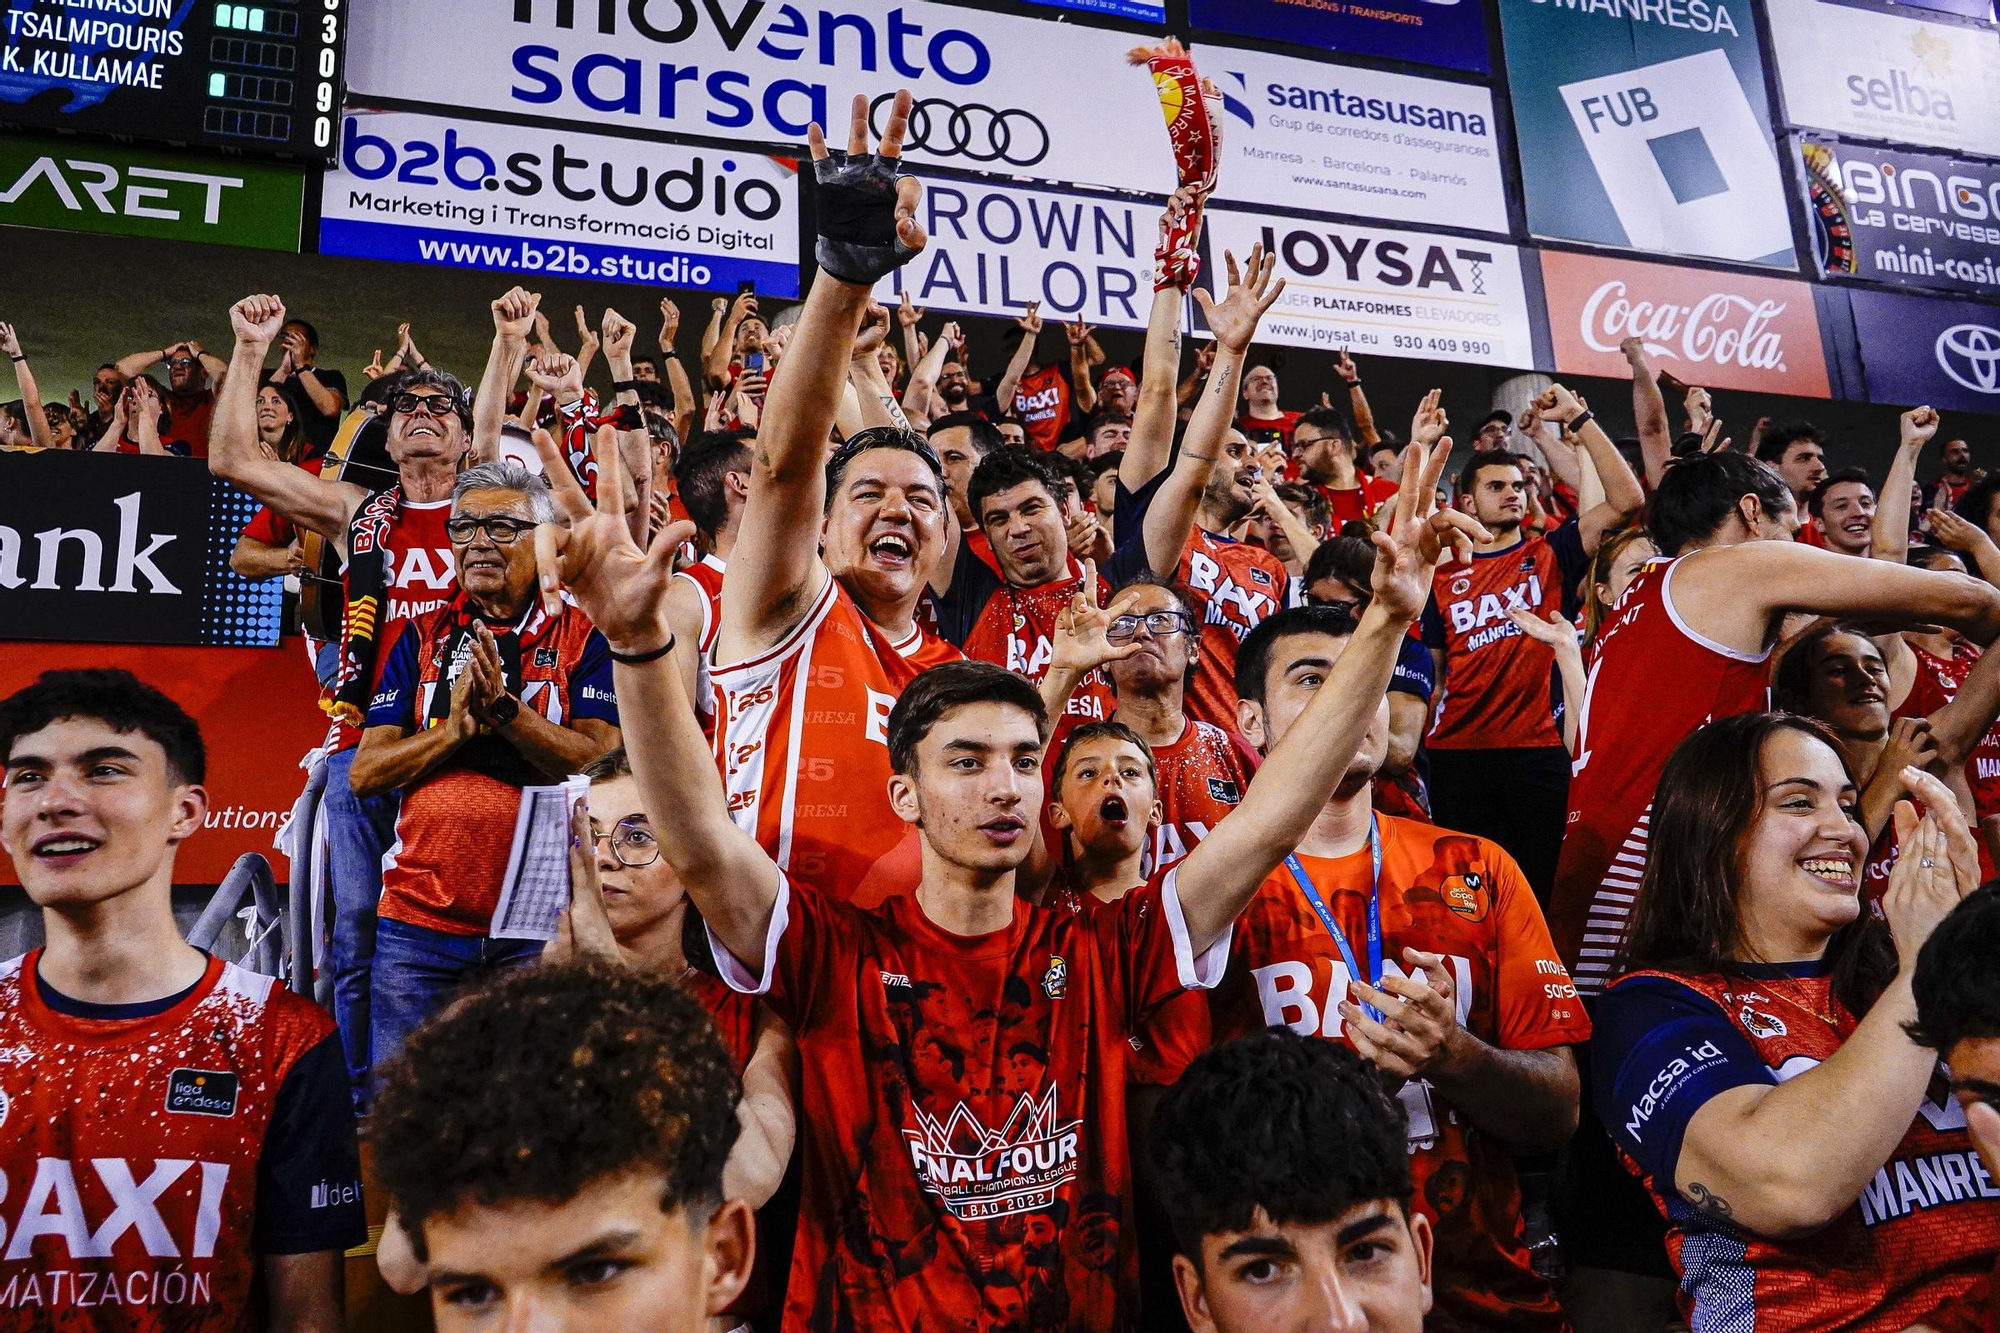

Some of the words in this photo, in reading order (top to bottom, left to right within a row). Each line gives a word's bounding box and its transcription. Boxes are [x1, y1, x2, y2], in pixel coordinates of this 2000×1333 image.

[8, 9, 184, 56] TSALMPOURIS
[321, 14, 337, 44] 3
[1350, 5, 1423, 26] TRANSPORTS
[2, 45, 25, 73] K.
[33, 49, 164, 90] KULLAMAE
[319, 47, 335, 78] 0
[316, 81, 332, 112] 9
[511, 44, 828, 138] sarsa
[1266, 82, 1487, 136] santasusana
[1581, 86, 1659, 134] FUB
[1846, 68, 1956, 121] selba
[313, 116, 331, 147] 0
[1268, 113, 1302, 132] Grup
[1305, 118, 1324, 134] de
[1327, 122, 1391, 144] corredors
[1392, 130, 1490, 158] d'assegurances
[342, 116, 782, 221] b2b.studio
[1243, 145, 1304, 165] Manresa
[1322, 155, 1391, 177] Barcelona
[1409, 166, 1469, 187] Palamós
[1291, 173, 1427, 200] www.santasusana.com
[349, 191, 485, 226] Marketing
[491, 204, 498, 224] i
[504, 206, 690, 243] Transformació
[697, 226, 775, 253] Digital
[926, 185, 1136, 259] ROWN
[1850, 204, 1887, 228] La
[418, 237, 712, 286] www.b2b.studio
[1243, 225, 1493, 296] JOYSAT
[1313, 296, 1413, 318] PLATAFORMES
[1415, 304, 1503, 327] ELEVADORES
[1579, 280, 1787, 373] Coca-Cola
[1267, 321, 1380, 346] www.joysat.eu
[1393, 333, 1423, 350] 930
[1427, 336, 1459, 352] 409
[1462, 339, 1491, 355] 990
[1016, 386, 1060, 412] BAXI
[1449, 574, 1543, 635] BAXI
[825, 619, 858, 645] RESA
[1062, 694, 1104, 722] ESA
[1449, 890, 1474, 900] Copa
[175, 1081, 203, 1096] liga
[1625, 1057, 1690, 1143] Macsa
[1685, 1039, 1723, 1062] id
[1663, 1084, 1678, 1103] code
[1677, 1073, 1693, 1089] you
[1692, 1064, 1708, 1075] can
[1707, 1057, 1730, 1067] trust
[173, 1095, 232, 1111] endesa
[996, 1132, 1078, 1178] FOUR
[329, 1180, 361, 1206] del
[973, 1173, 1037, 1194] CHAMPIONS
[1038, 1160, 1078, 1183] LEAGUE
[0, 1156, 231, 1261] AXI
[950, 1201, 999, 1218] ILBAO
[1007, 1193, 1046, 1211] 2022
